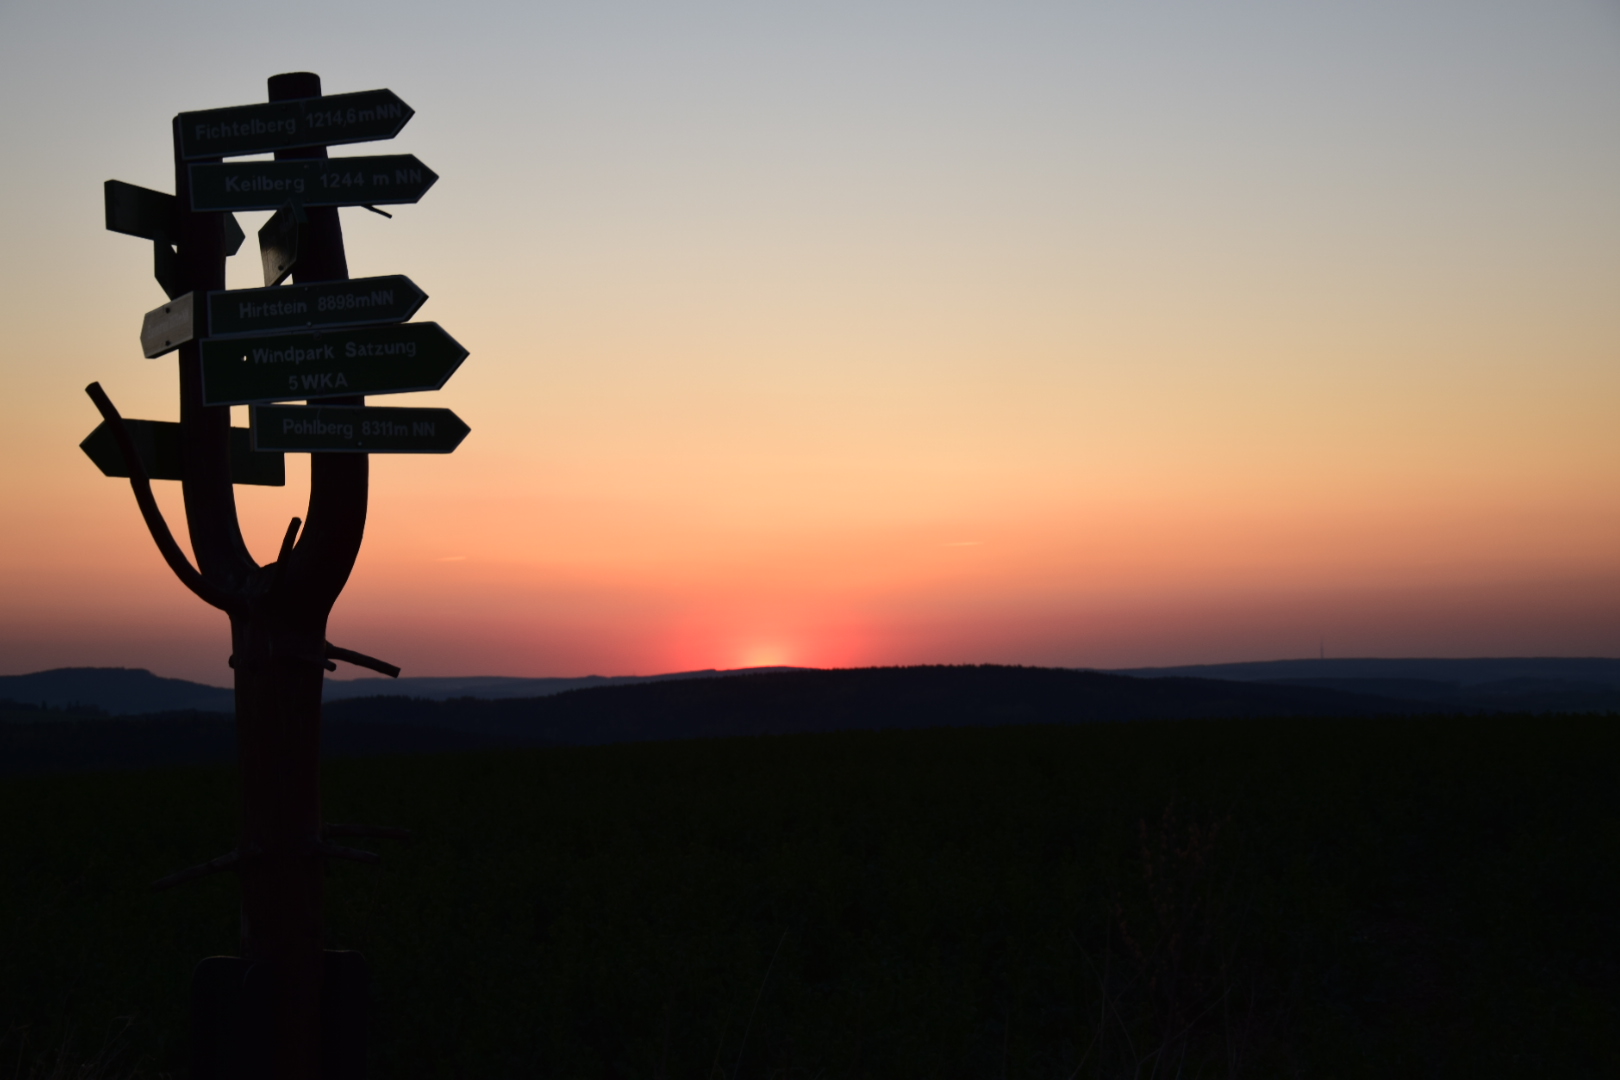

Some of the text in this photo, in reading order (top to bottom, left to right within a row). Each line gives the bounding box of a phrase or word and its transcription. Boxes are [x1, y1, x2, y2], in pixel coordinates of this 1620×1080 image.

[195, 117, 296, 141] Fichtelberg
[225, 169, 422, 193] Keilberg 1244 m NN
[239, 301, 307, 319] Hirtstein
[252, 340, 417, 365] Windpark Satzung
[283, 418, 353, 439] Pöhlberg
